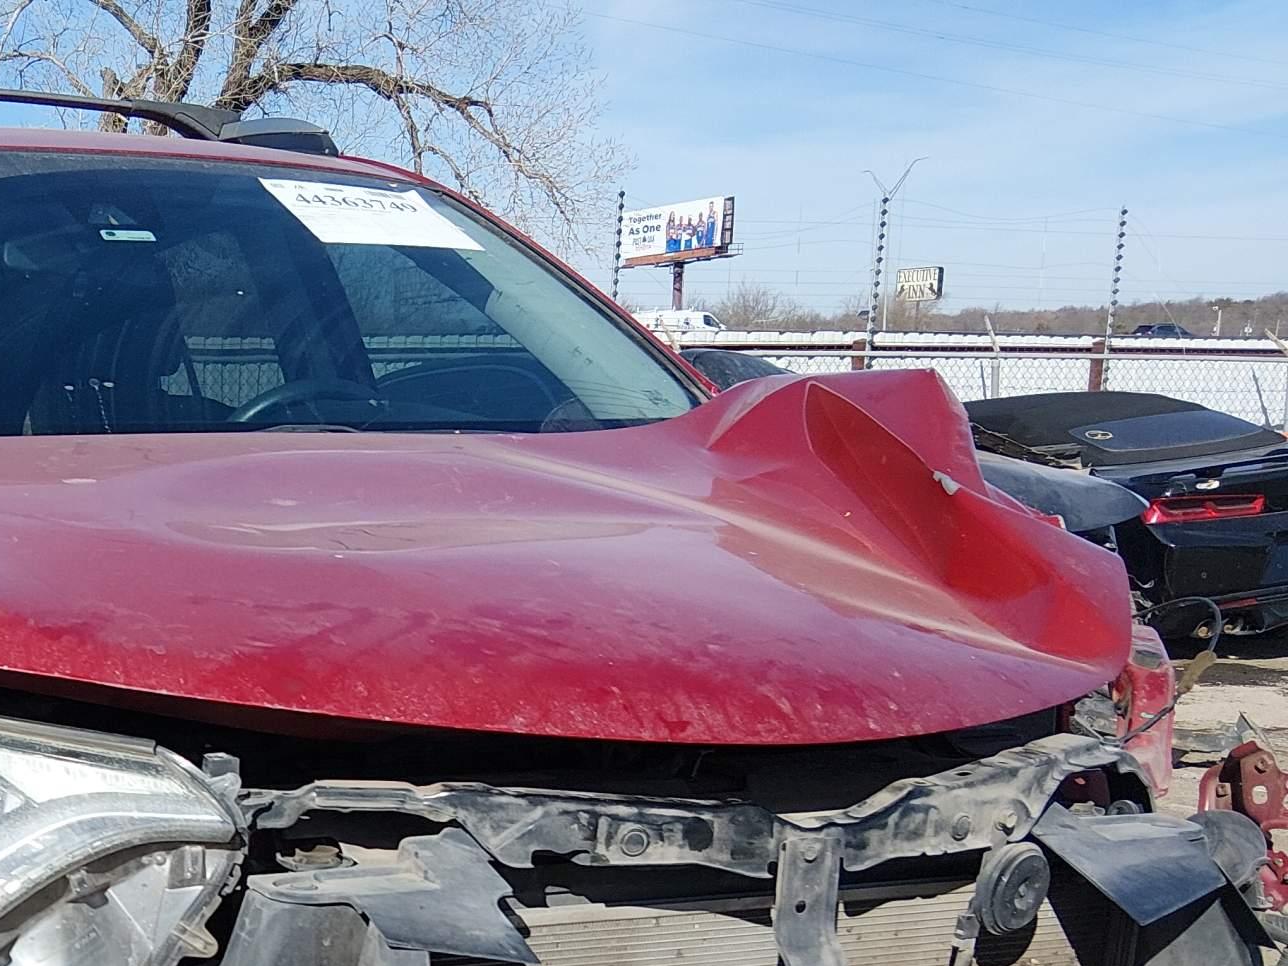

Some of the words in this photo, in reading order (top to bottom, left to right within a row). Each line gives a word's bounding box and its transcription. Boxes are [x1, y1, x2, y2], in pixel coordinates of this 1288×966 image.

[295, 193, 418, 213] 44363749
[629, 213, 662, 224] Together
[628, 227, 641, 236] As
[642, 224, 662, 234] One
[896, 269, 937, 283] EXECUTIVE
[908, 284, 925, 299] INN
